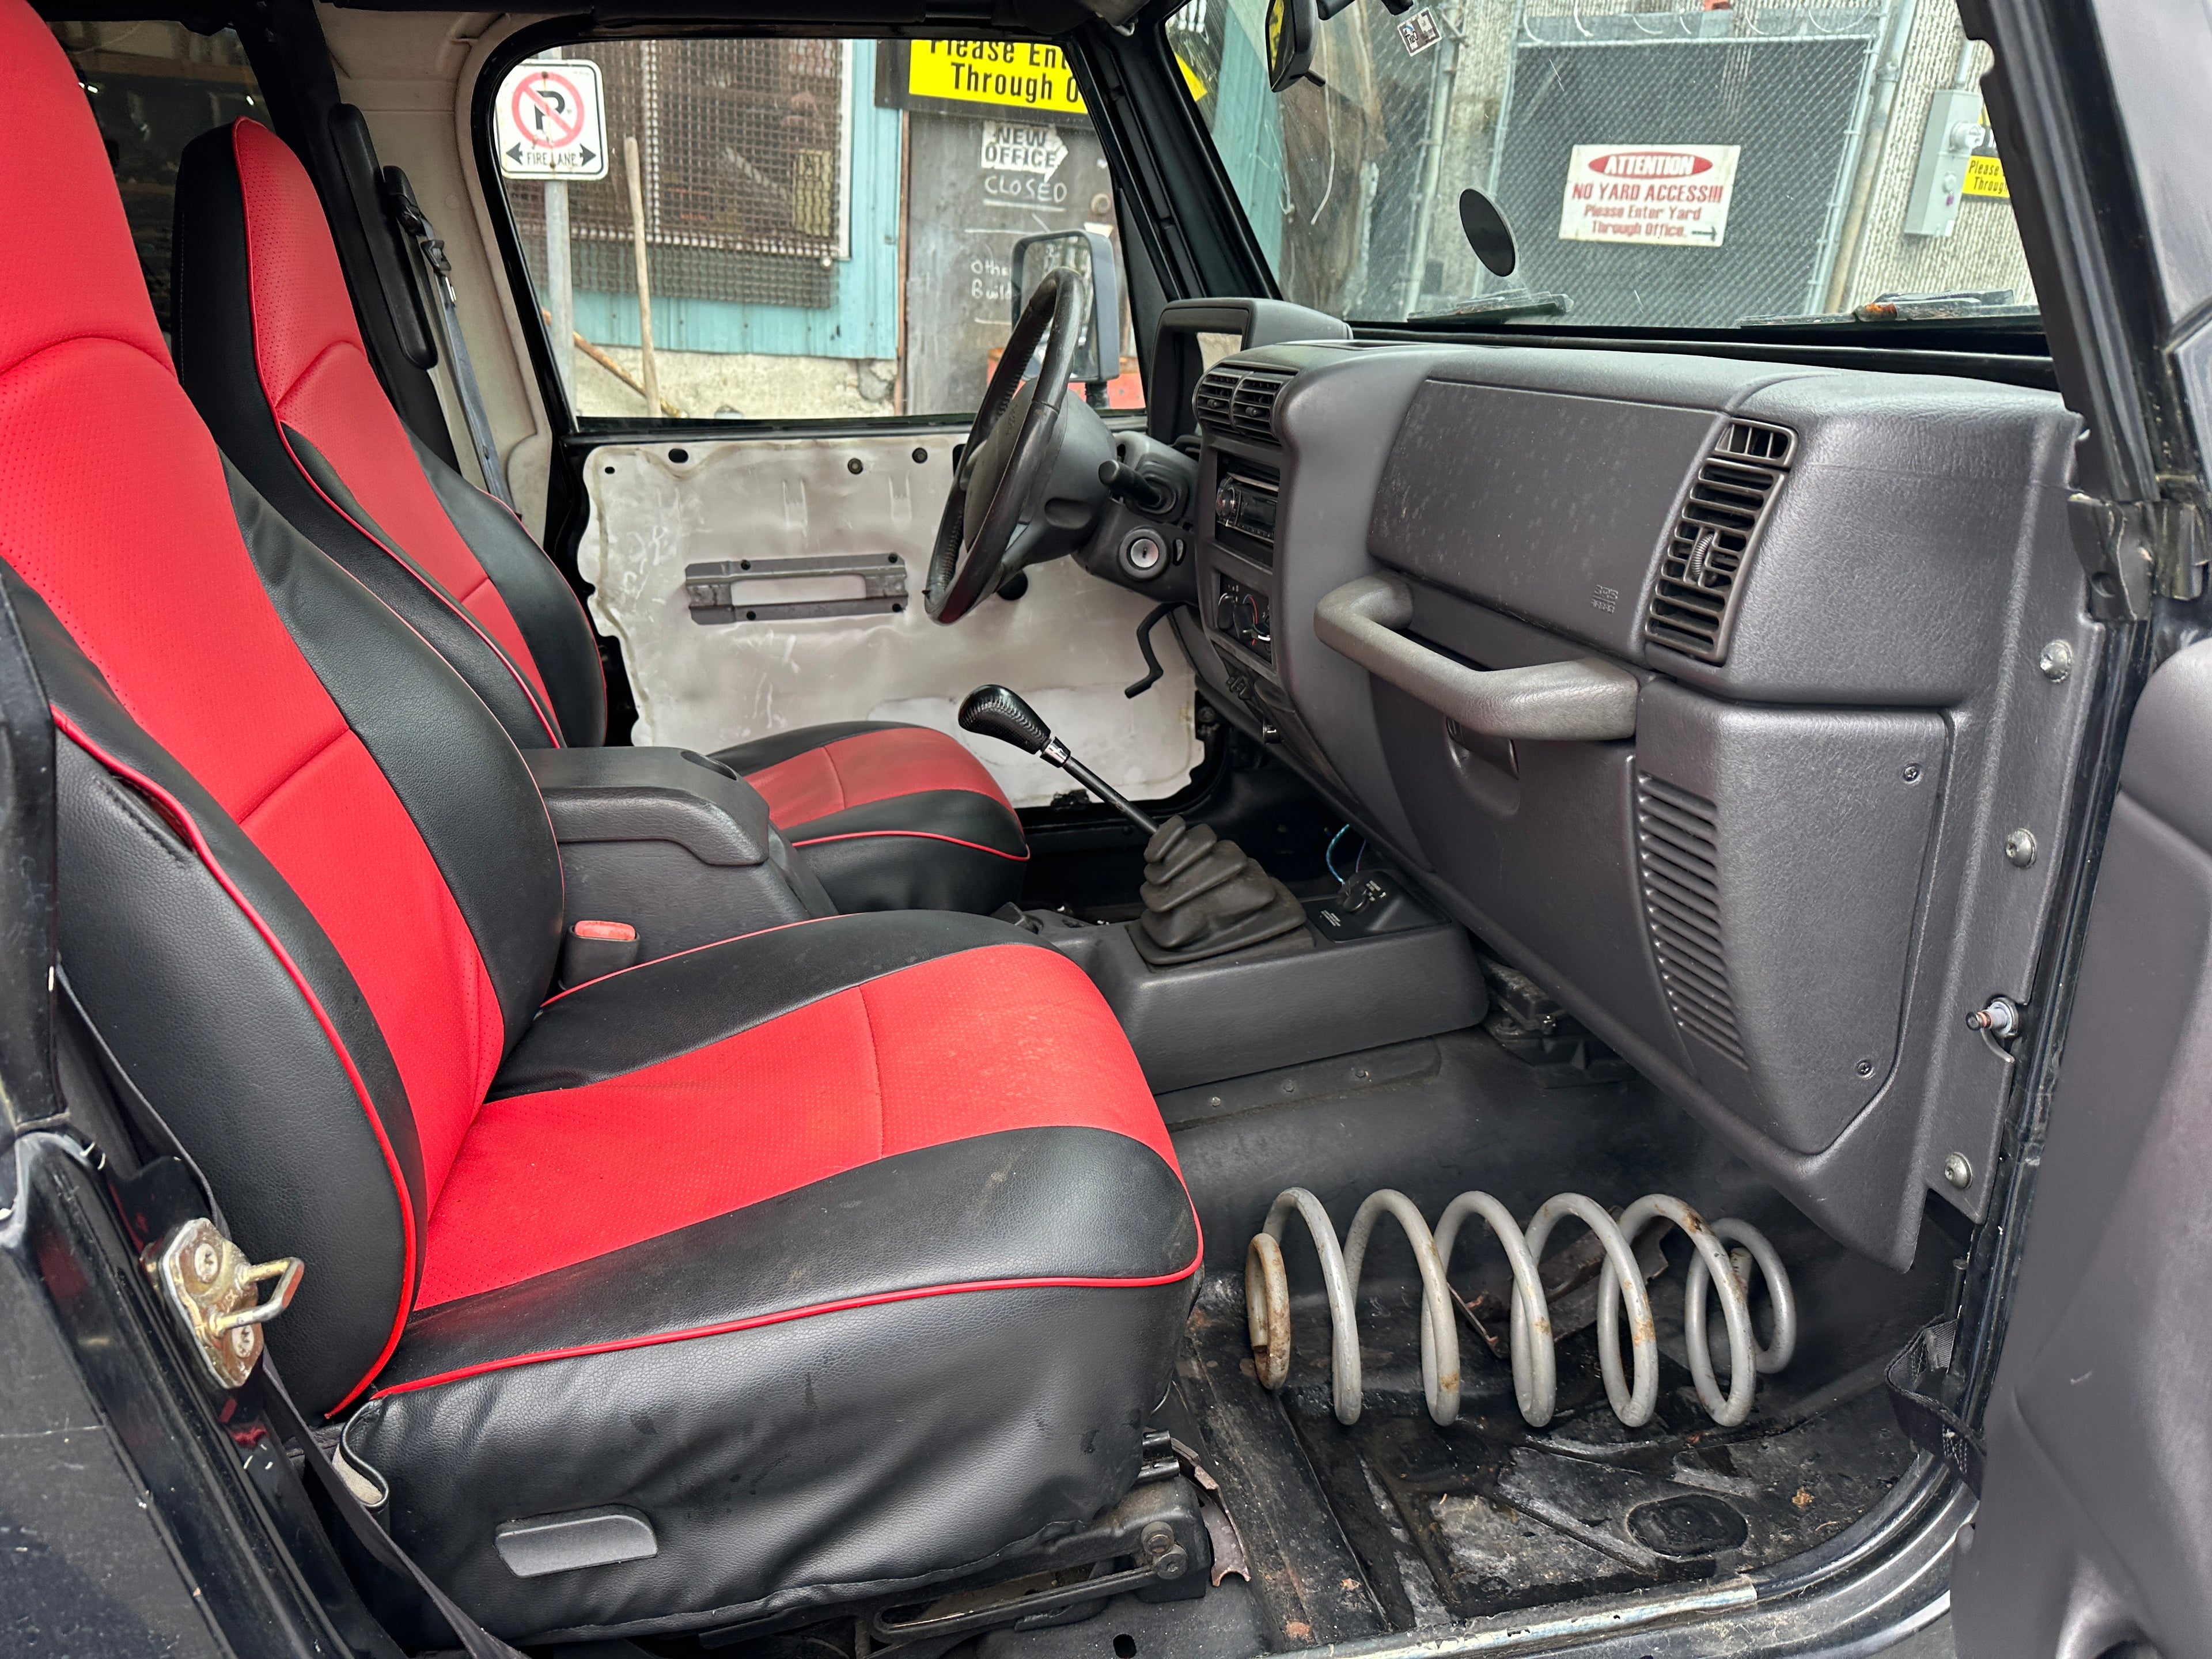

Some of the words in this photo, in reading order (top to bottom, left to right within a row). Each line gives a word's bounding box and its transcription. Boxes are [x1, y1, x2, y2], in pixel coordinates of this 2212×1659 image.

[951, 62, 1052, 103] Through
[997, 127, 1047, 147] NEW
[527, 151, 548, 166] FIRE
[985, 143, 1056, 169] OFFICE
[1603, 155, 1695, 175] ATTENTION
[1968, 160, 2000, 176] Please
[984, 175, 1067, 203] CLOSED
[1572, 182, 1593, 200] NO
[1599, 183, 1641, 201] YARD
[1584, 203, 1624, 218] Please
[1628, 204, 1665, 219] Enter
[1669, 205, 1702, 221] Yard
[1592, 219, 1641, 237] Through
